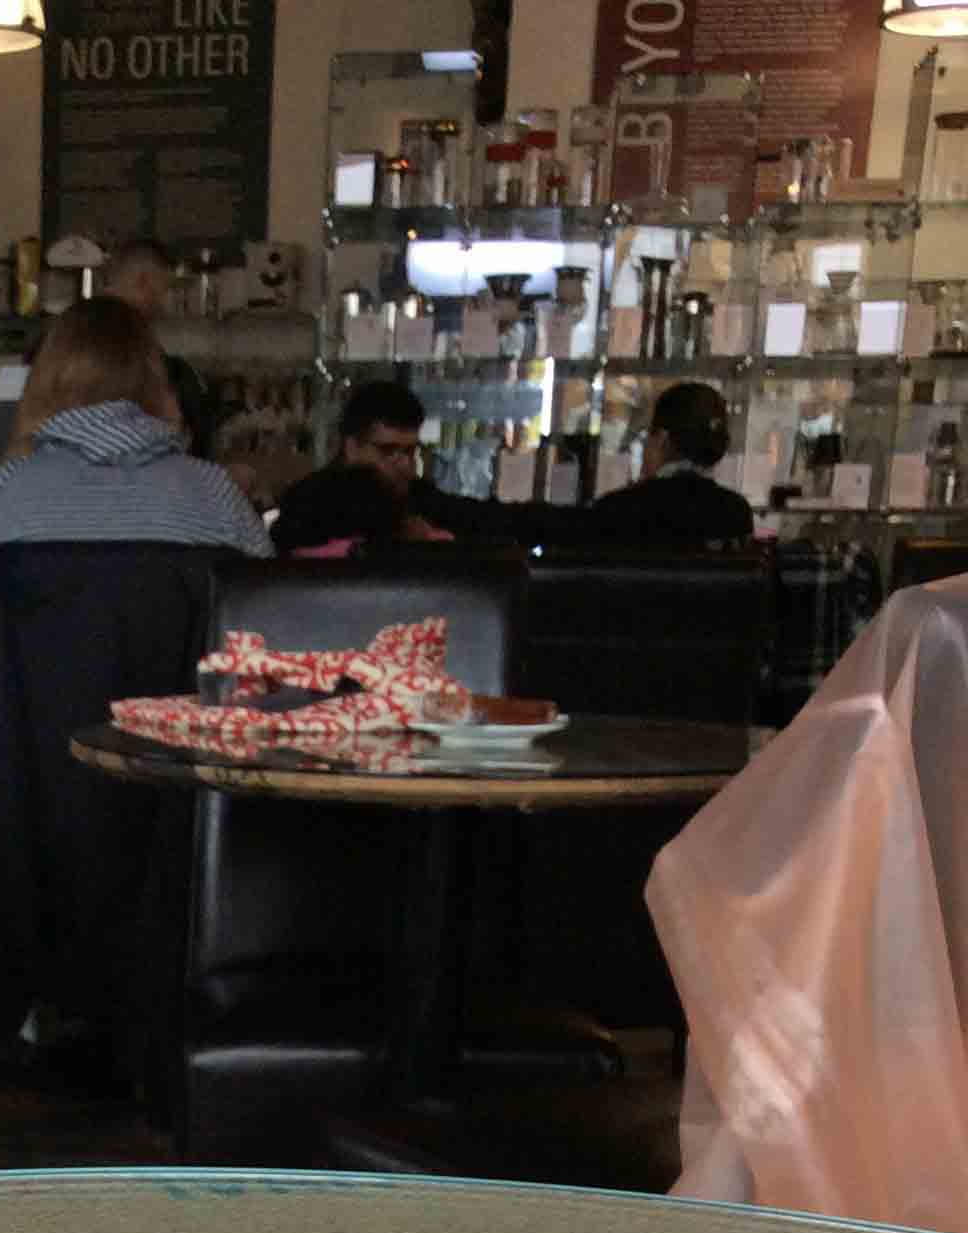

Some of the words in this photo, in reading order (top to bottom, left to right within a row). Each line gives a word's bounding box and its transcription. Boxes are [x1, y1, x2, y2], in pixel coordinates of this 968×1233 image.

[173, 0, 249, 28] LIKE
[60, 37, 115, 80] NO
[128, 34, 249, 79] OTHER
